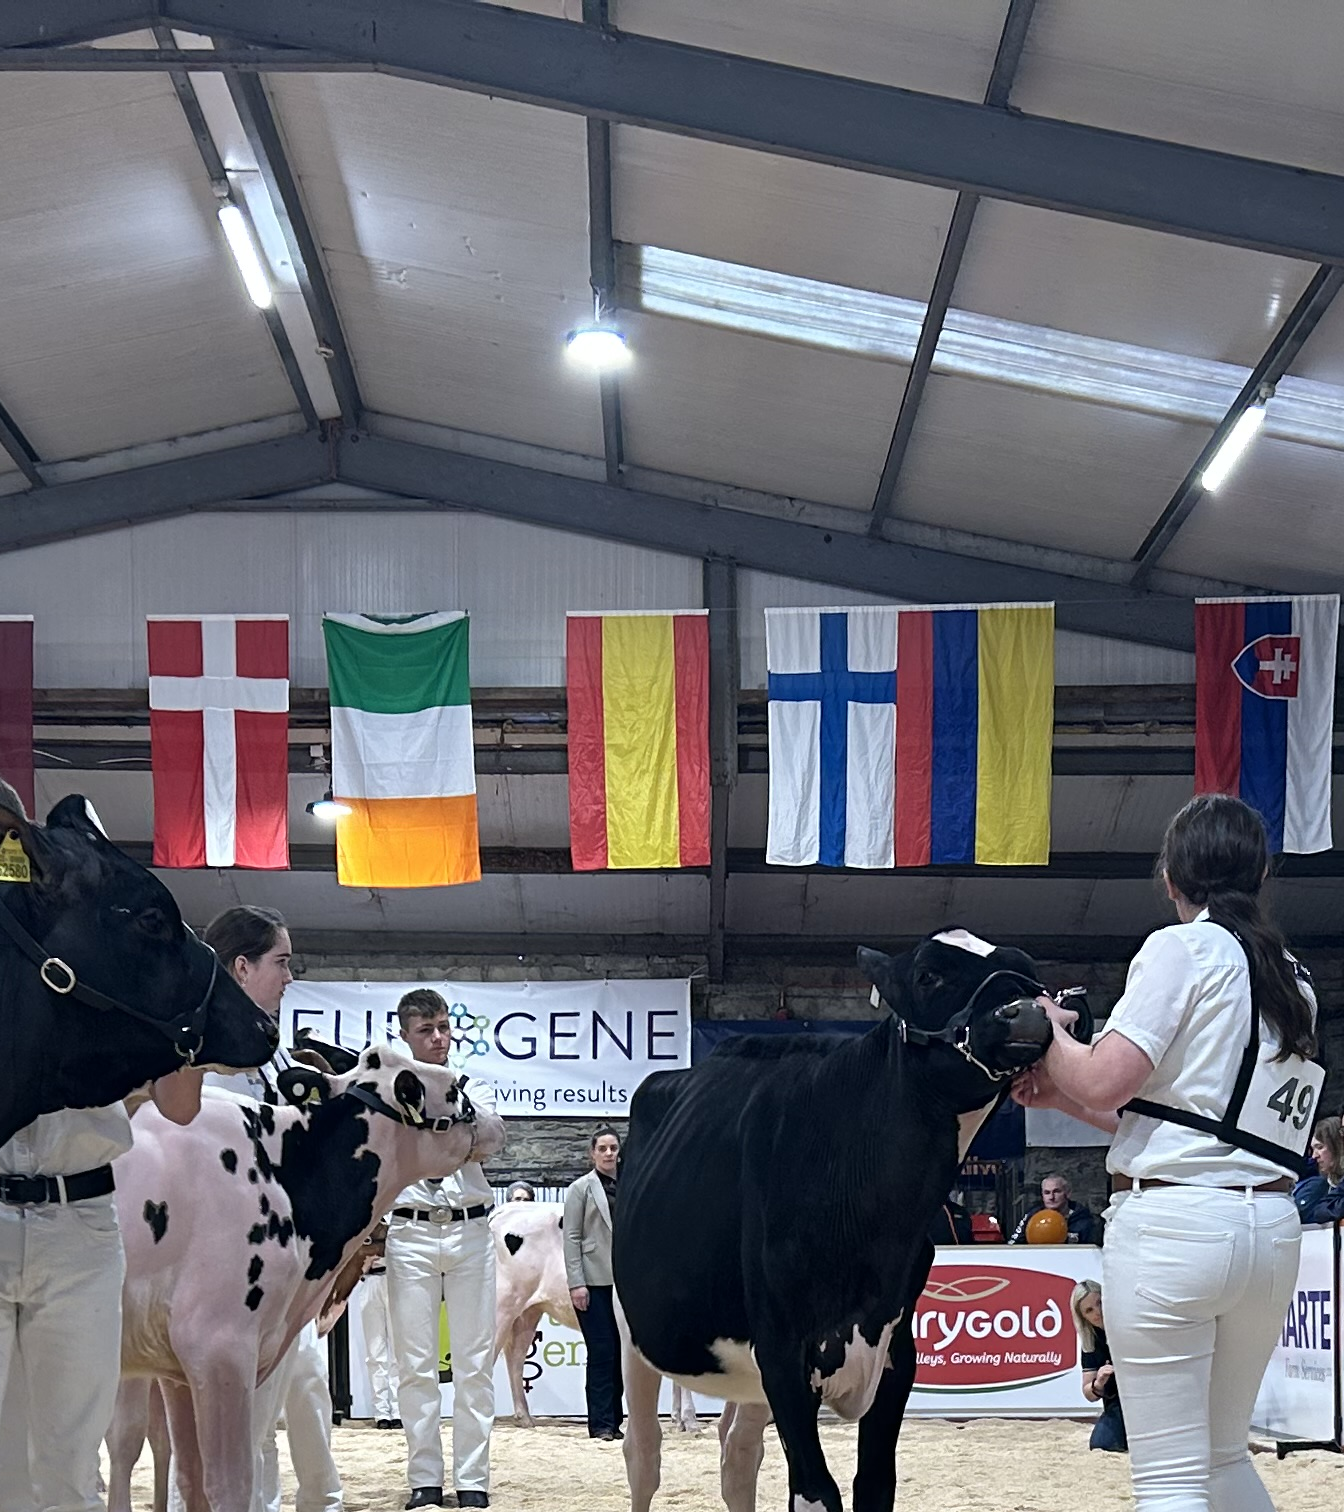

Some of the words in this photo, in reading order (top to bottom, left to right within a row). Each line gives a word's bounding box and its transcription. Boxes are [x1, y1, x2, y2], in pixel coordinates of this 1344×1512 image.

[292, 1008, 678, 1062] EUGENE
[494, 1080, 547, 1111] iving
[554, 1080, 628, 1103] results
[1266, 1076, 1315, 1131] 49
[1282, 1290, 1331, 1350] ARTE
[916, 1351, 946, 1367] lleys,
[950, 1351, 1001, 1367] Growing
[1004, 1351, 1062, 1366] Naturally
